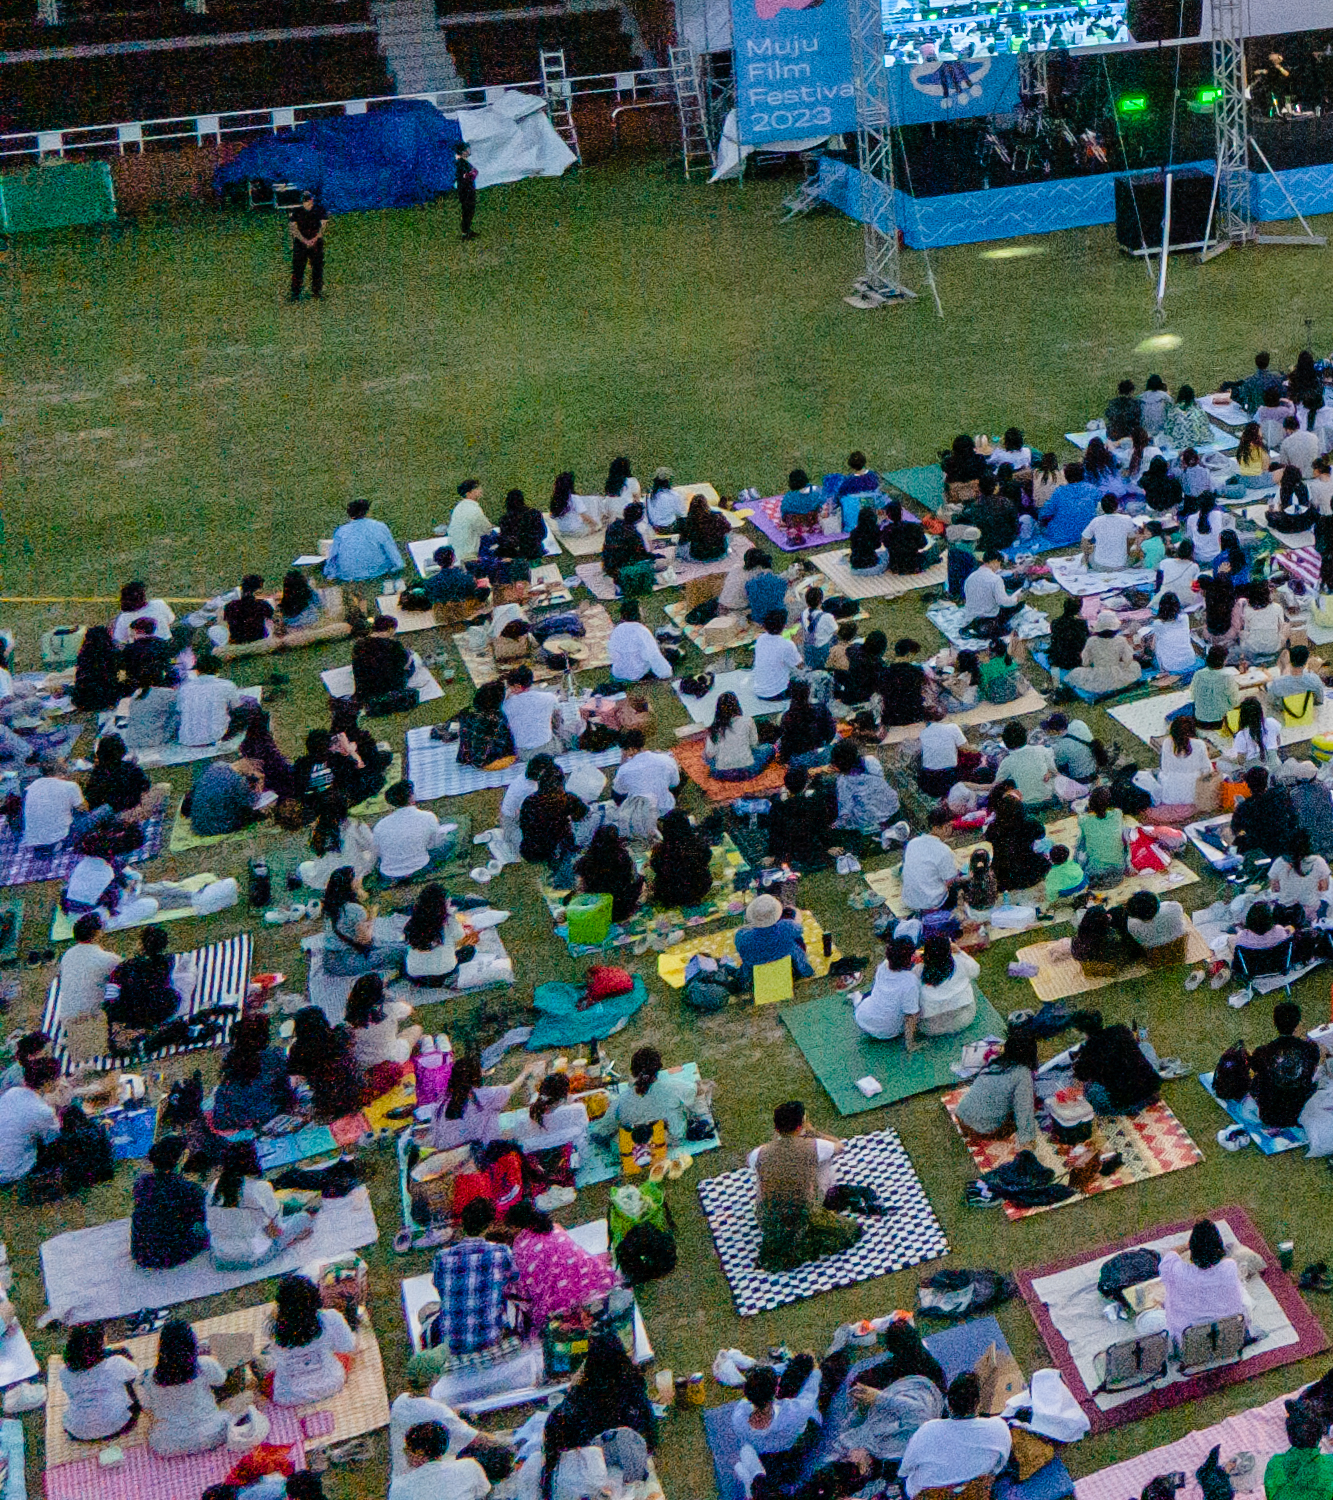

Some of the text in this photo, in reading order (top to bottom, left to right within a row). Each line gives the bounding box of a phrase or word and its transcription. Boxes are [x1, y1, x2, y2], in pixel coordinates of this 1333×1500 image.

[746, 33, 819, 58] Muju
[748, 60, 811, 82] Film
[748, 83, 855, 107] Festiva
[751, 106, 832, 132] 2023
